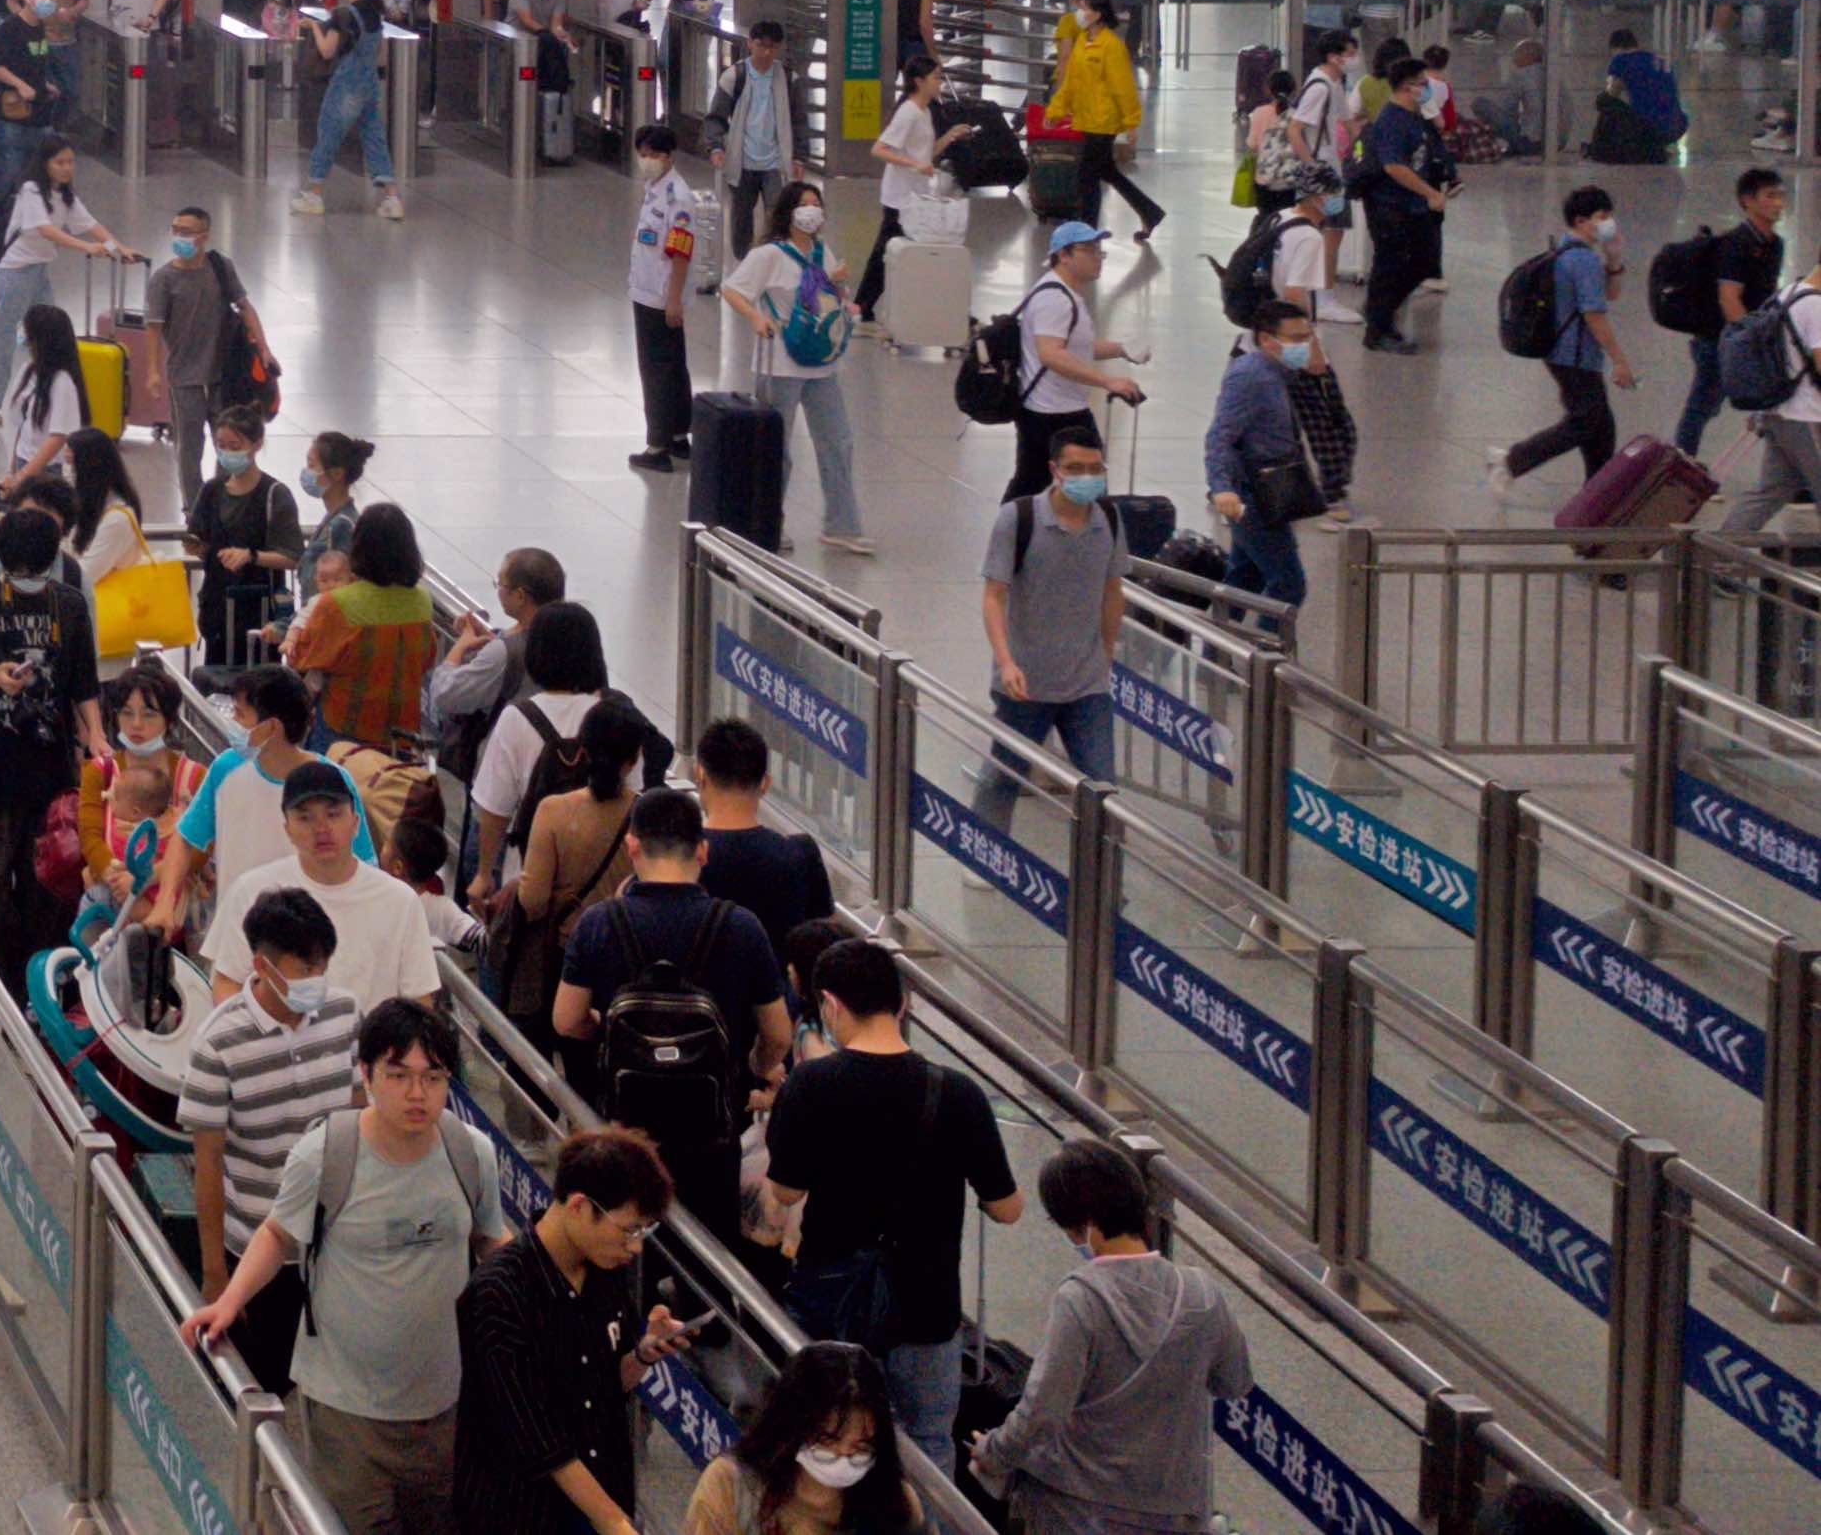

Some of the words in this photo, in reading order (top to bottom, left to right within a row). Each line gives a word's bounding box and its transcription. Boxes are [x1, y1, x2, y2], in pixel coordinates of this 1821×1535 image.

[758, 659, 817, 734] 安检进站
[959, 817, 1020, 890] 安检进站
[1335, 809, 1425, 885] 安检进站
[1738, 816, 1821, 885] 安检进站
[1172, 971, 1246, 1056] 安检进站
[1601, 958, 1689, 1035] 安检进站
[12, 1173, 36, 1230] 出口
[1433, 1142, 1547, 1236] 安检进站
[157, 1423, 183, 1496] 出口
[680, 1387, 732, 1462] 安检
[1225, 1396, 1341, 1523] 安检进站
[1777, 1388, 1821, 1459] 安
